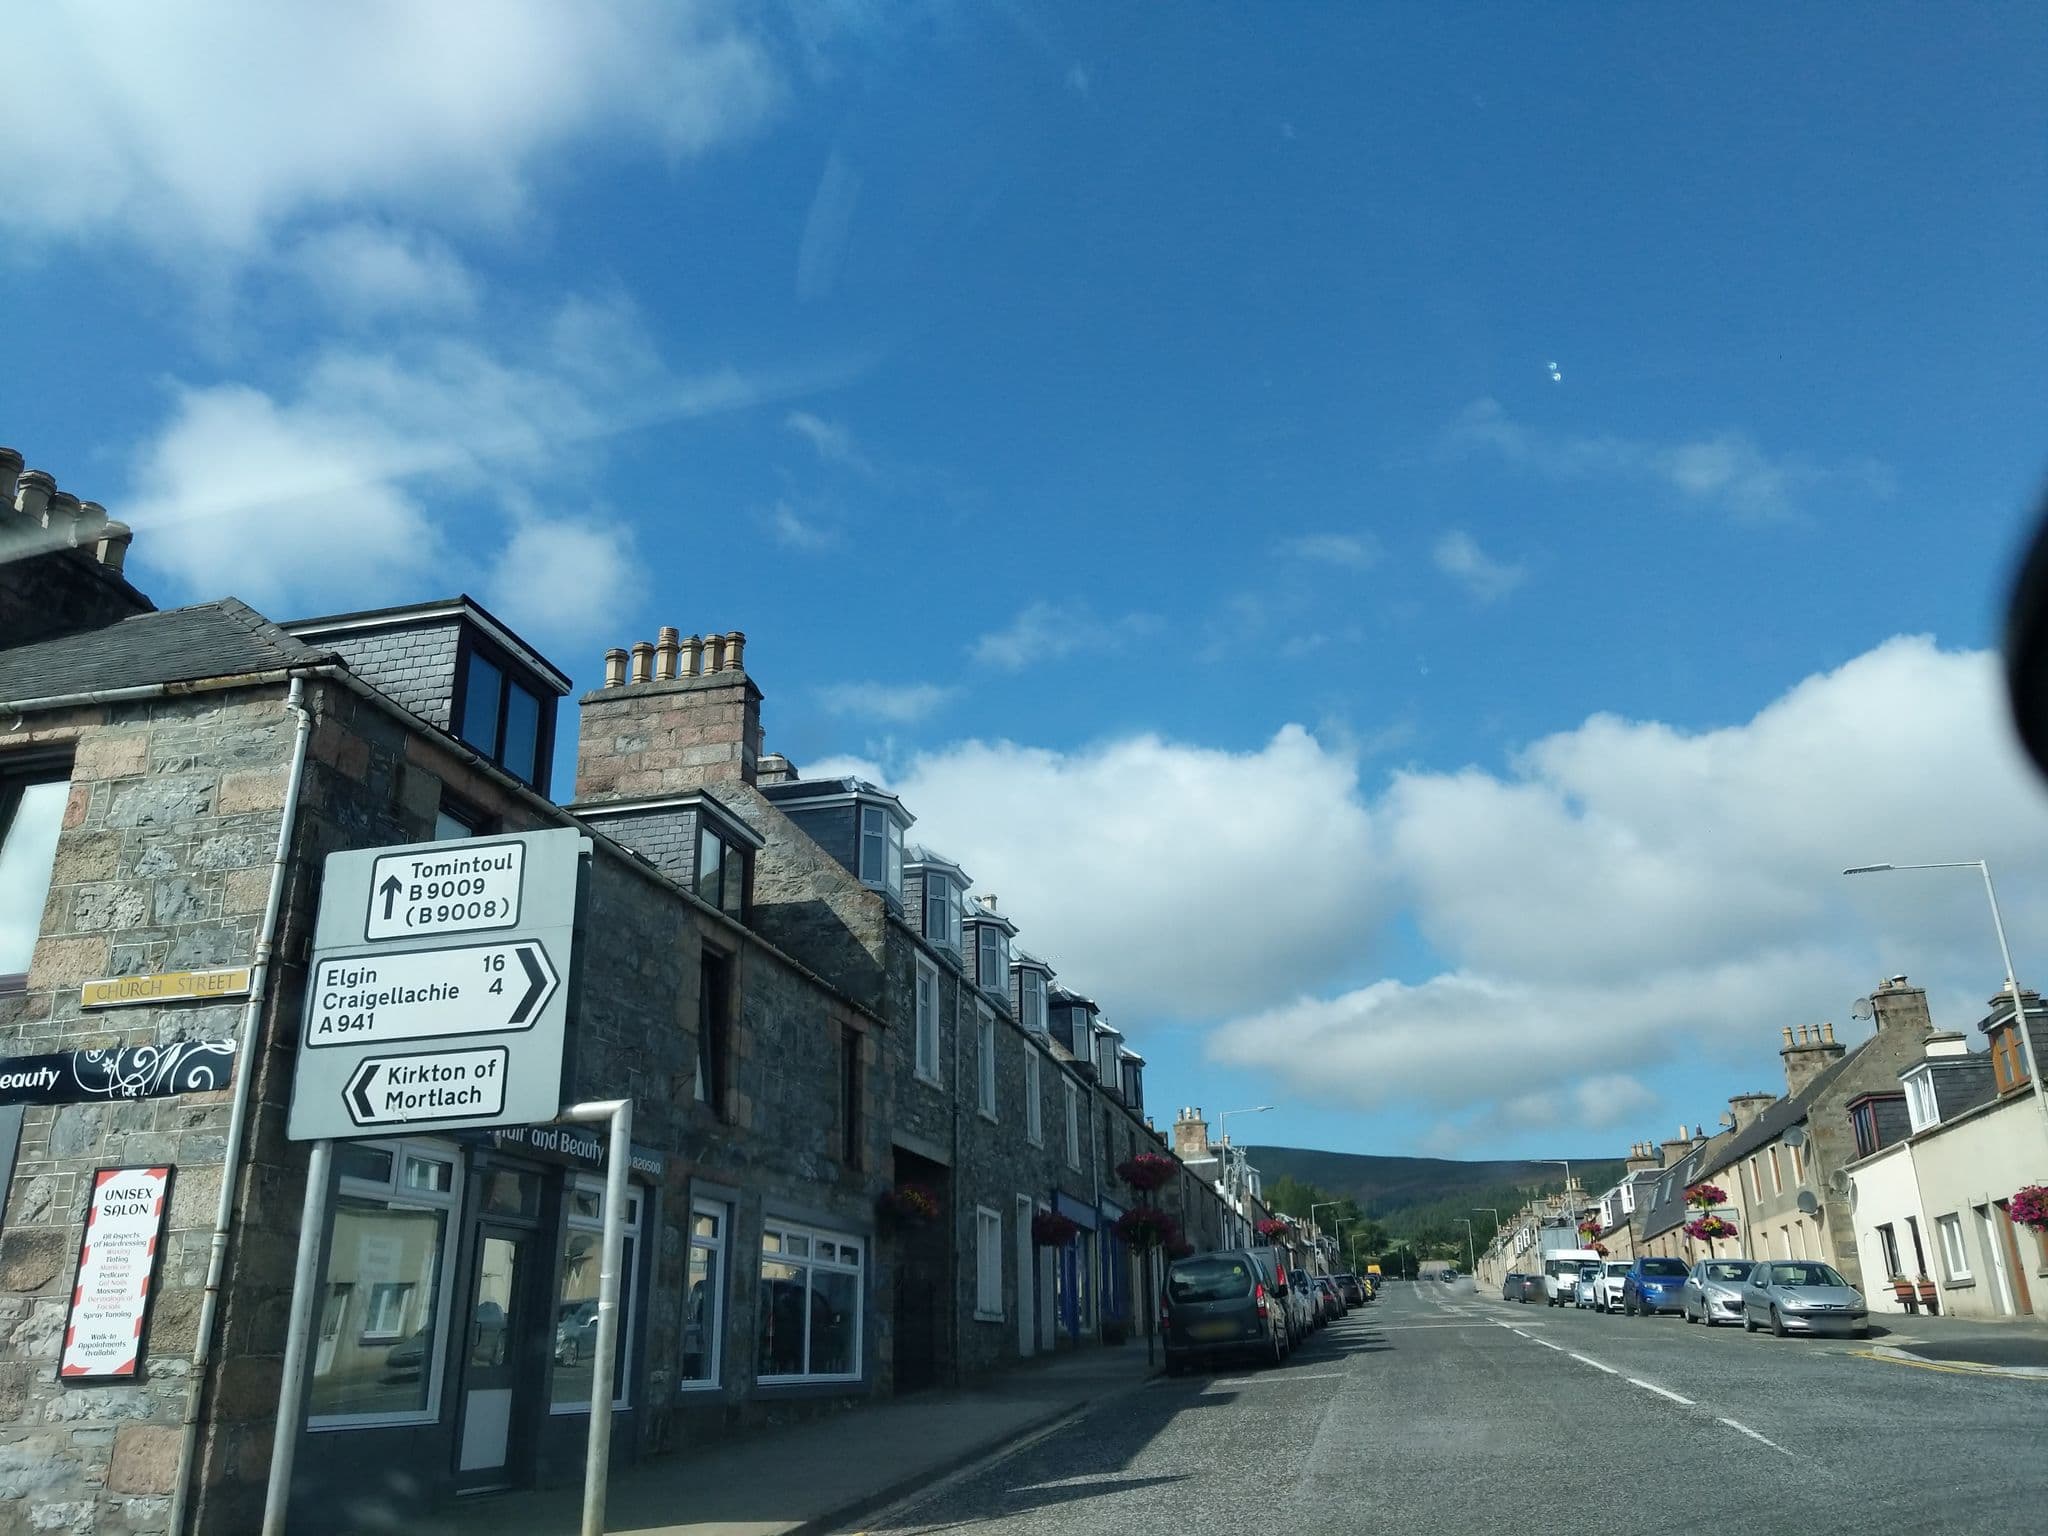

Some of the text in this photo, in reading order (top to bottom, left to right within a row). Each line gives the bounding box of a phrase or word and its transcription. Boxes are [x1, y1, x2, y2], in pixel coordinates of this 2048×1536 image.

[411, 853, 513, 879] Tomintoul
[409, 878, 486, 901] B9009
[405, 897, 509, 927] (B9008)
[326, 954, 505, 988] Elgin 16
[96, 974, 236, 1000] CHURCH STREET
[323, 977, 503, 1010] Craigellachie 4
[318, 1012, 375, 1034] A941
[0, 1067, 61, 1090] eauty
[388, 1059, 497, 1086] Kirkton of
[385, 1086, 482, 1110] Mortlach
[532, 1128, 558, 1151] and
[560, 1132, 605, 1168] Beauty
[105, 1188, 153, 1201] UNISEX
[104, 1204, 148, 1217] SALON
